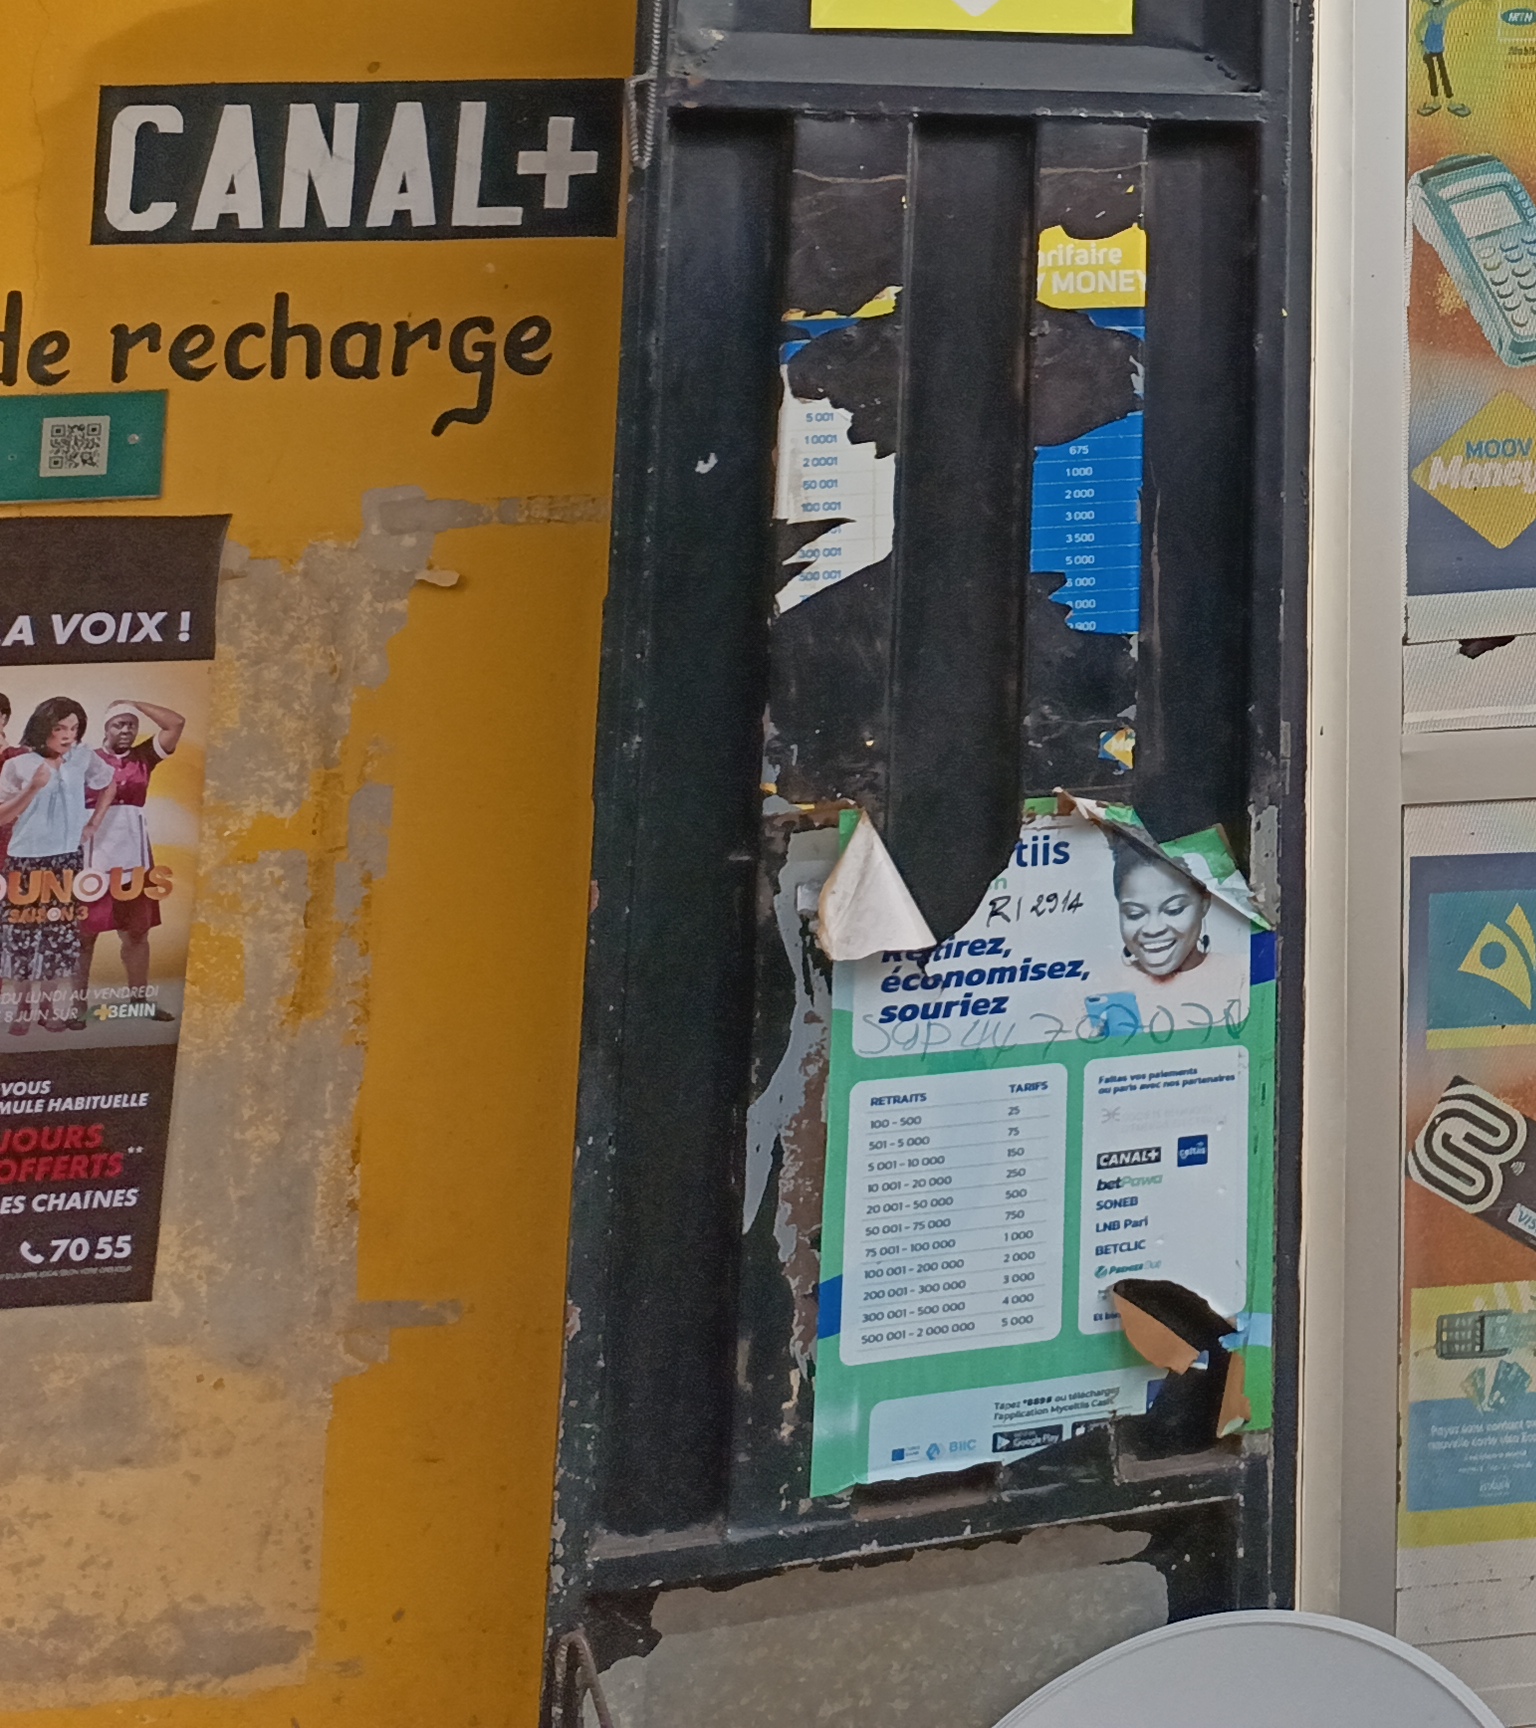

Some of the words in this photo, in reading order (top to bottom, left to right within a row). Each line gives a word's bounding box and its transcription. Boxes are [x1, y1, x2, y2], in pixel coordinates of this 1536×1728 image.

[1508, 12, 1534, 22] MTN
[105, 101, 598, 232] CANAL+
[110, 291, 553, 437] recharge
[1069, 445, 1089, 455] 675
[1465, 438, 1533, 459] MOOV
[51, 611, 168, 645] VOIX
[178, 611, 191, 642] !
[881, 957, 1090, 993] économisez,
[93, 985, 160, 1000] VENDREDI
[879, 992, 1010, 1023] souriez
[0, 1080, 52, 1096] VOUS
[1008, 1081, 1049, 1094] TARIFS
[47, 1093, 149, 1112] HABITUELLE
[870, 1093, 927, 1106] RETRAITS
[1008, 1106, 1020, 1116] 25
[0, 1123, 105, 1155] JOURS
[1008, 1126, 1020, 1136] 75
[1007, 1147, 1024, 1157] 150
[1099, 1148, 1160, 1168] CANAL+
[1005, 1188, 1027, 1200] 500
[1096, 1196, 1138, 1210] SONEB
[1096, 1220, 1120, 1233] LNB
[1124, 1216, 1149, 1229] Pari
[49, 1237, 90, 1263] 70
[94, 1235, 132, 1260] 55
[1095, 1239, 1146, 1256] BETCLIC
